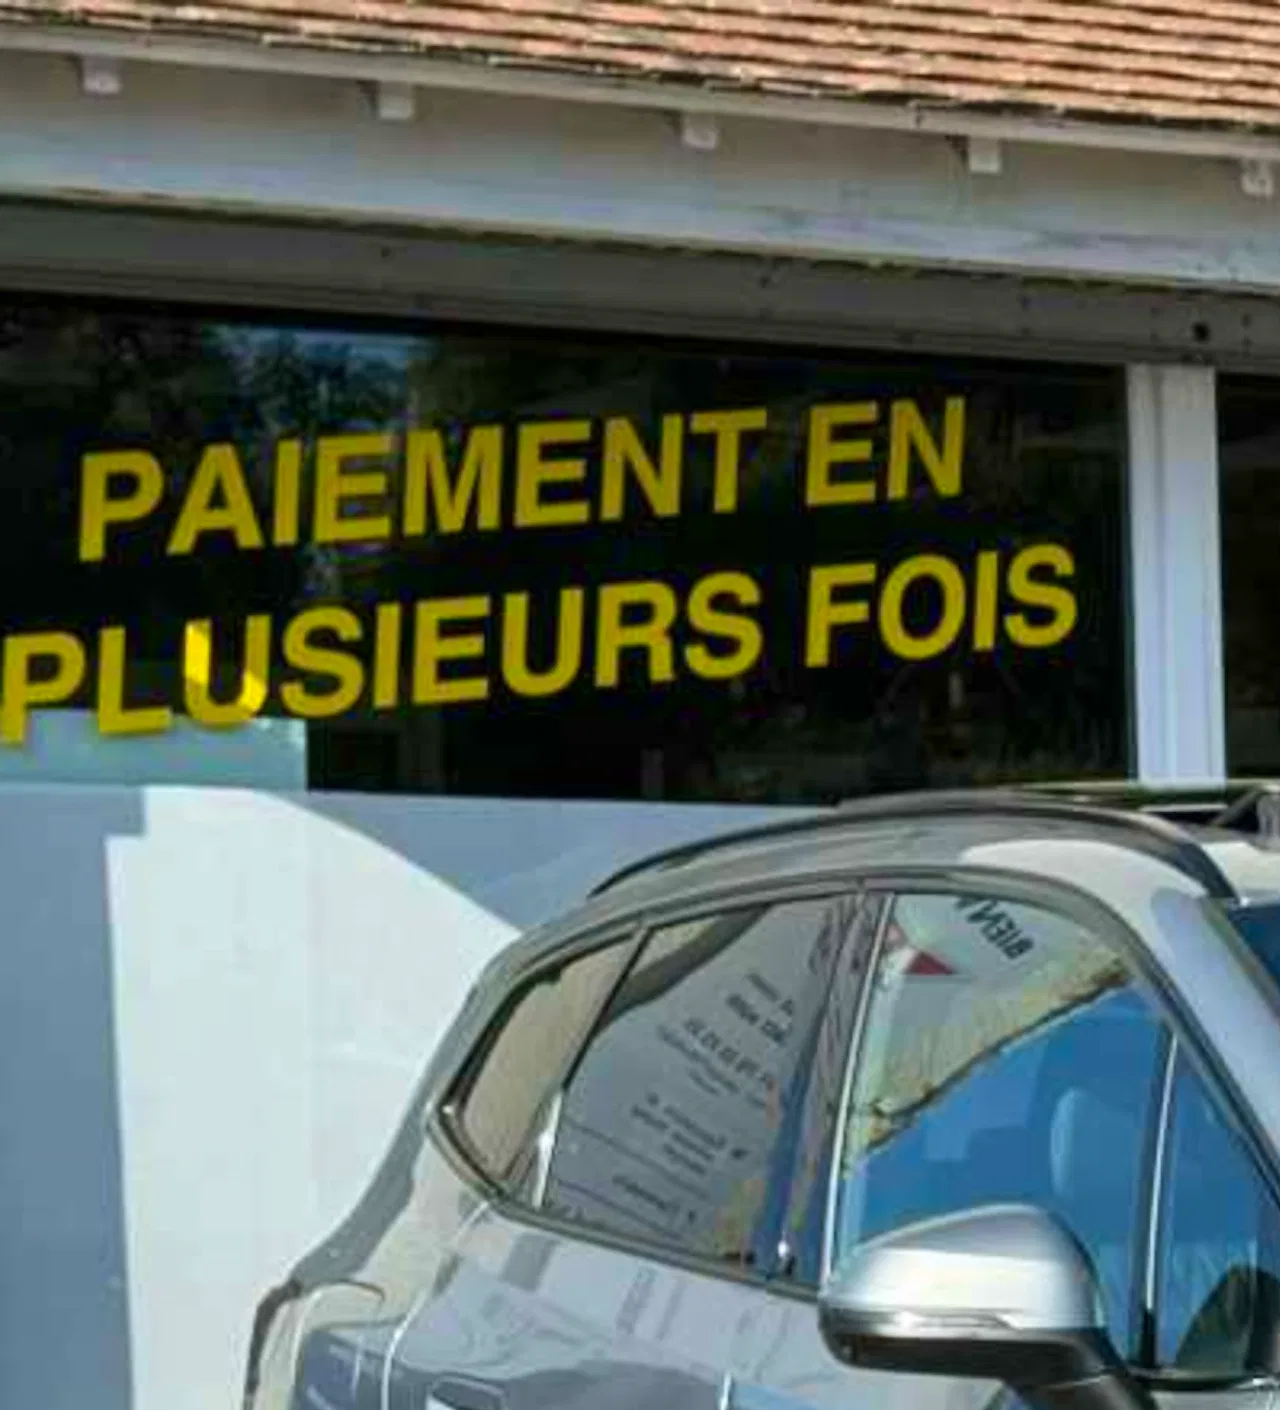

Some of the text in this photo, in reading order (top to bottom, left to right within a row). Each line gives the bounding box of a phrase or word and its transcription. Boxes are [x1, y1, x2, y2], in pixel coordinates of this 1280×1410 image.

[77, 398, 967, 563] PAIEMENT EN
[0, 542, 1079, 745] PLUSIEURS FOIS
